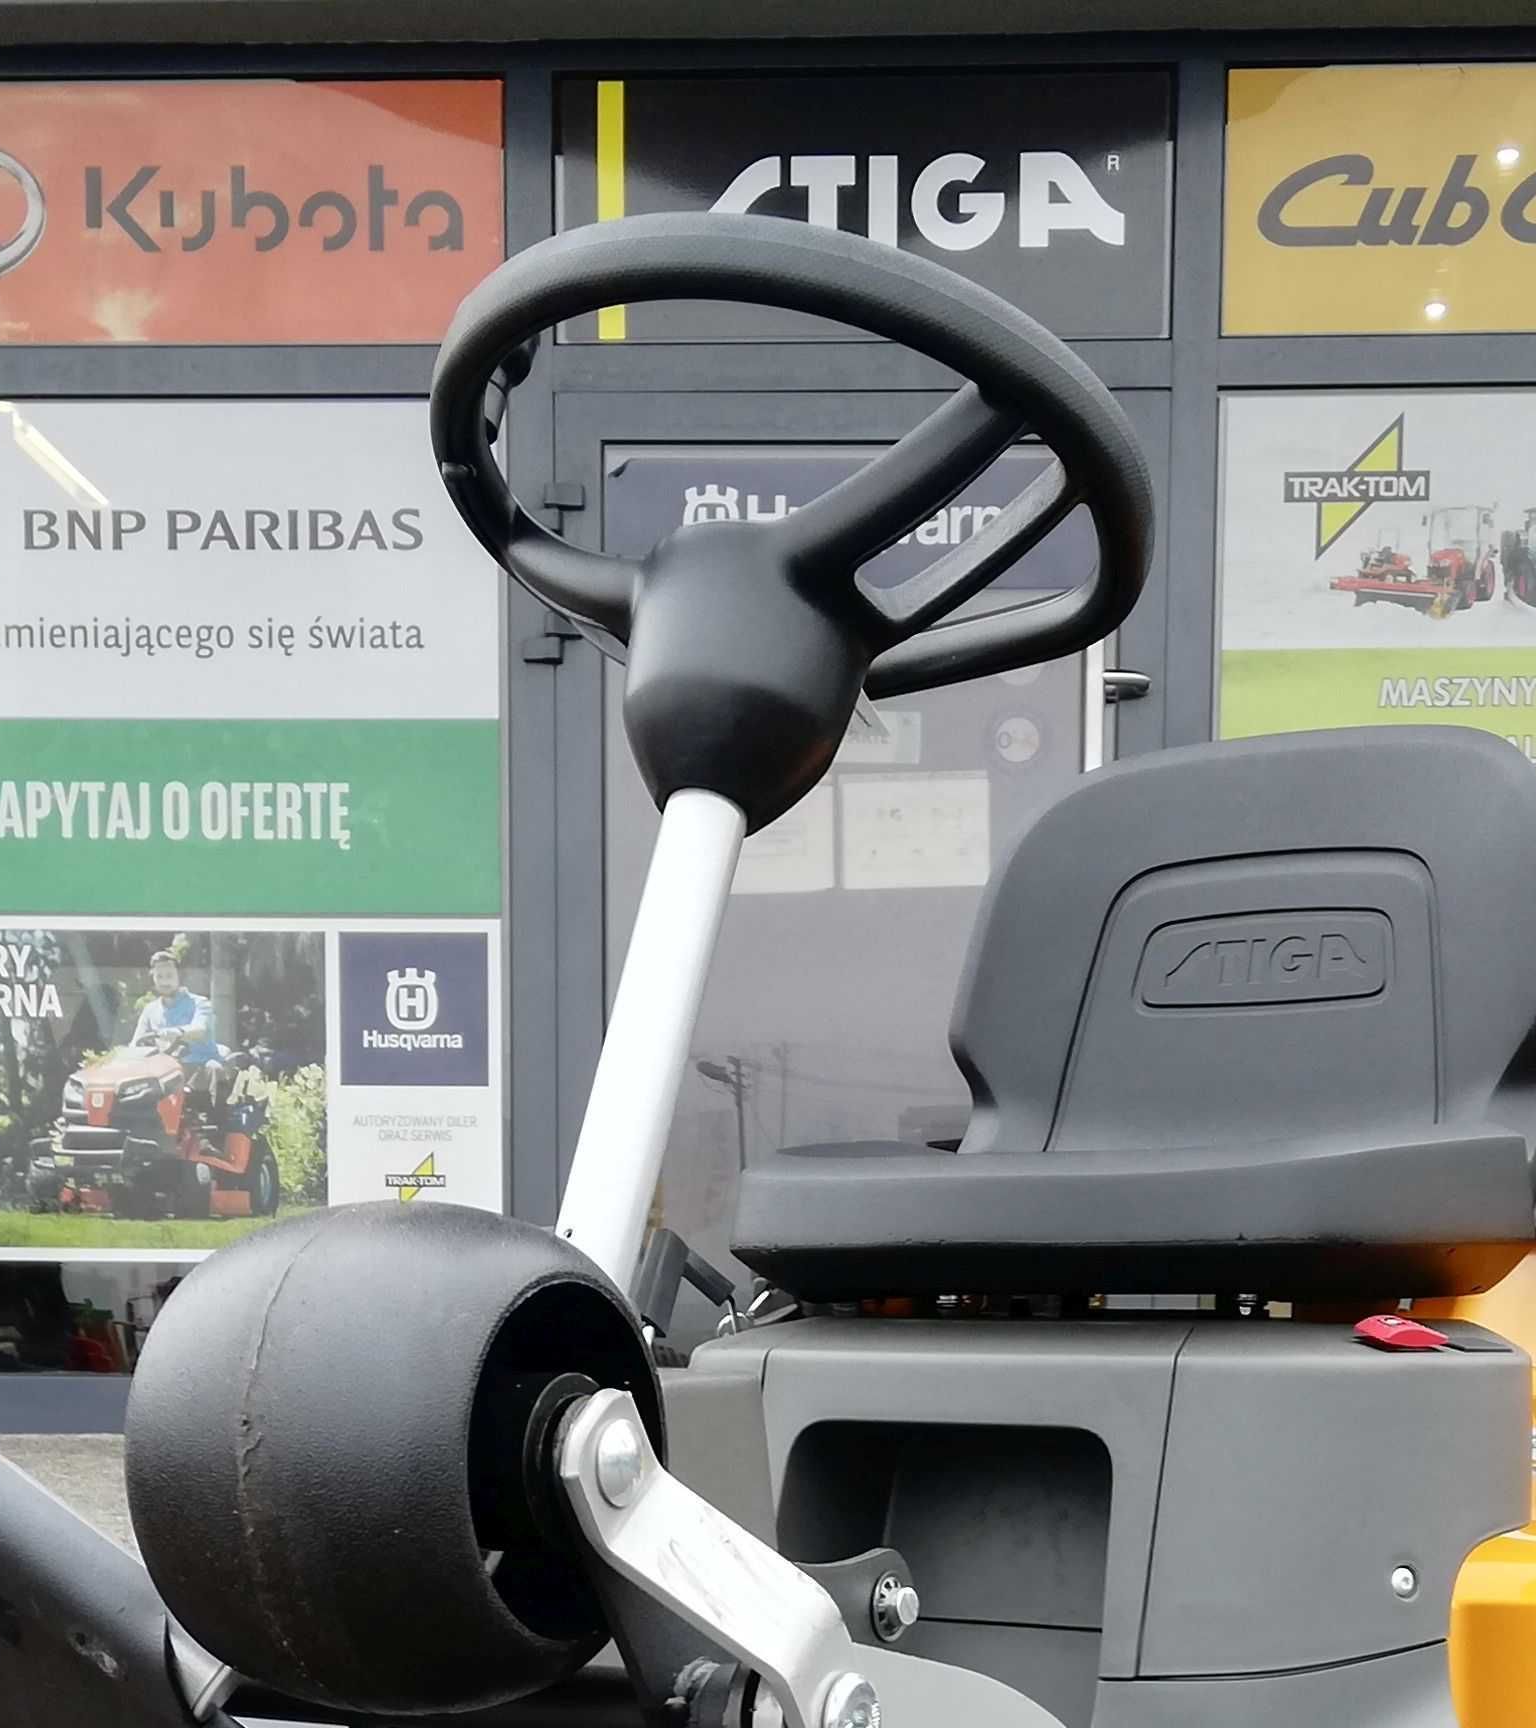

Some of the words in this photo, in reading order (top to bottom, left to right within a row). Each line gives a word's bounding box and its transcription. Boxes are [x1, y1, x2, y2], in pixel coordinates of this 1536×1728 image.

[83, 163, 464, 253] Kubota
[1257, 153, 1490, 247] Cub
[1288, 474, 1426, 499] TRAK-TOM
[22, 508, 147, 552] BNP
[166, 507, 425, 552] PARIBAS
[248, 618, 295, 657] się
[308, 615, 425, 651] świata
[163, 782, 190, 841] O
[199, 782, 351, 849] OFERTĘ
[1164, 933, 1367, 987] STIGA
[363, 1030, 464, 1051] Husqvarna
[352, 1116, 444, 1128] AUTORYZOWANY
[378, 1129, 409, 1141] ORAZ
[411, 1129, 453, 1141] SERWIS
